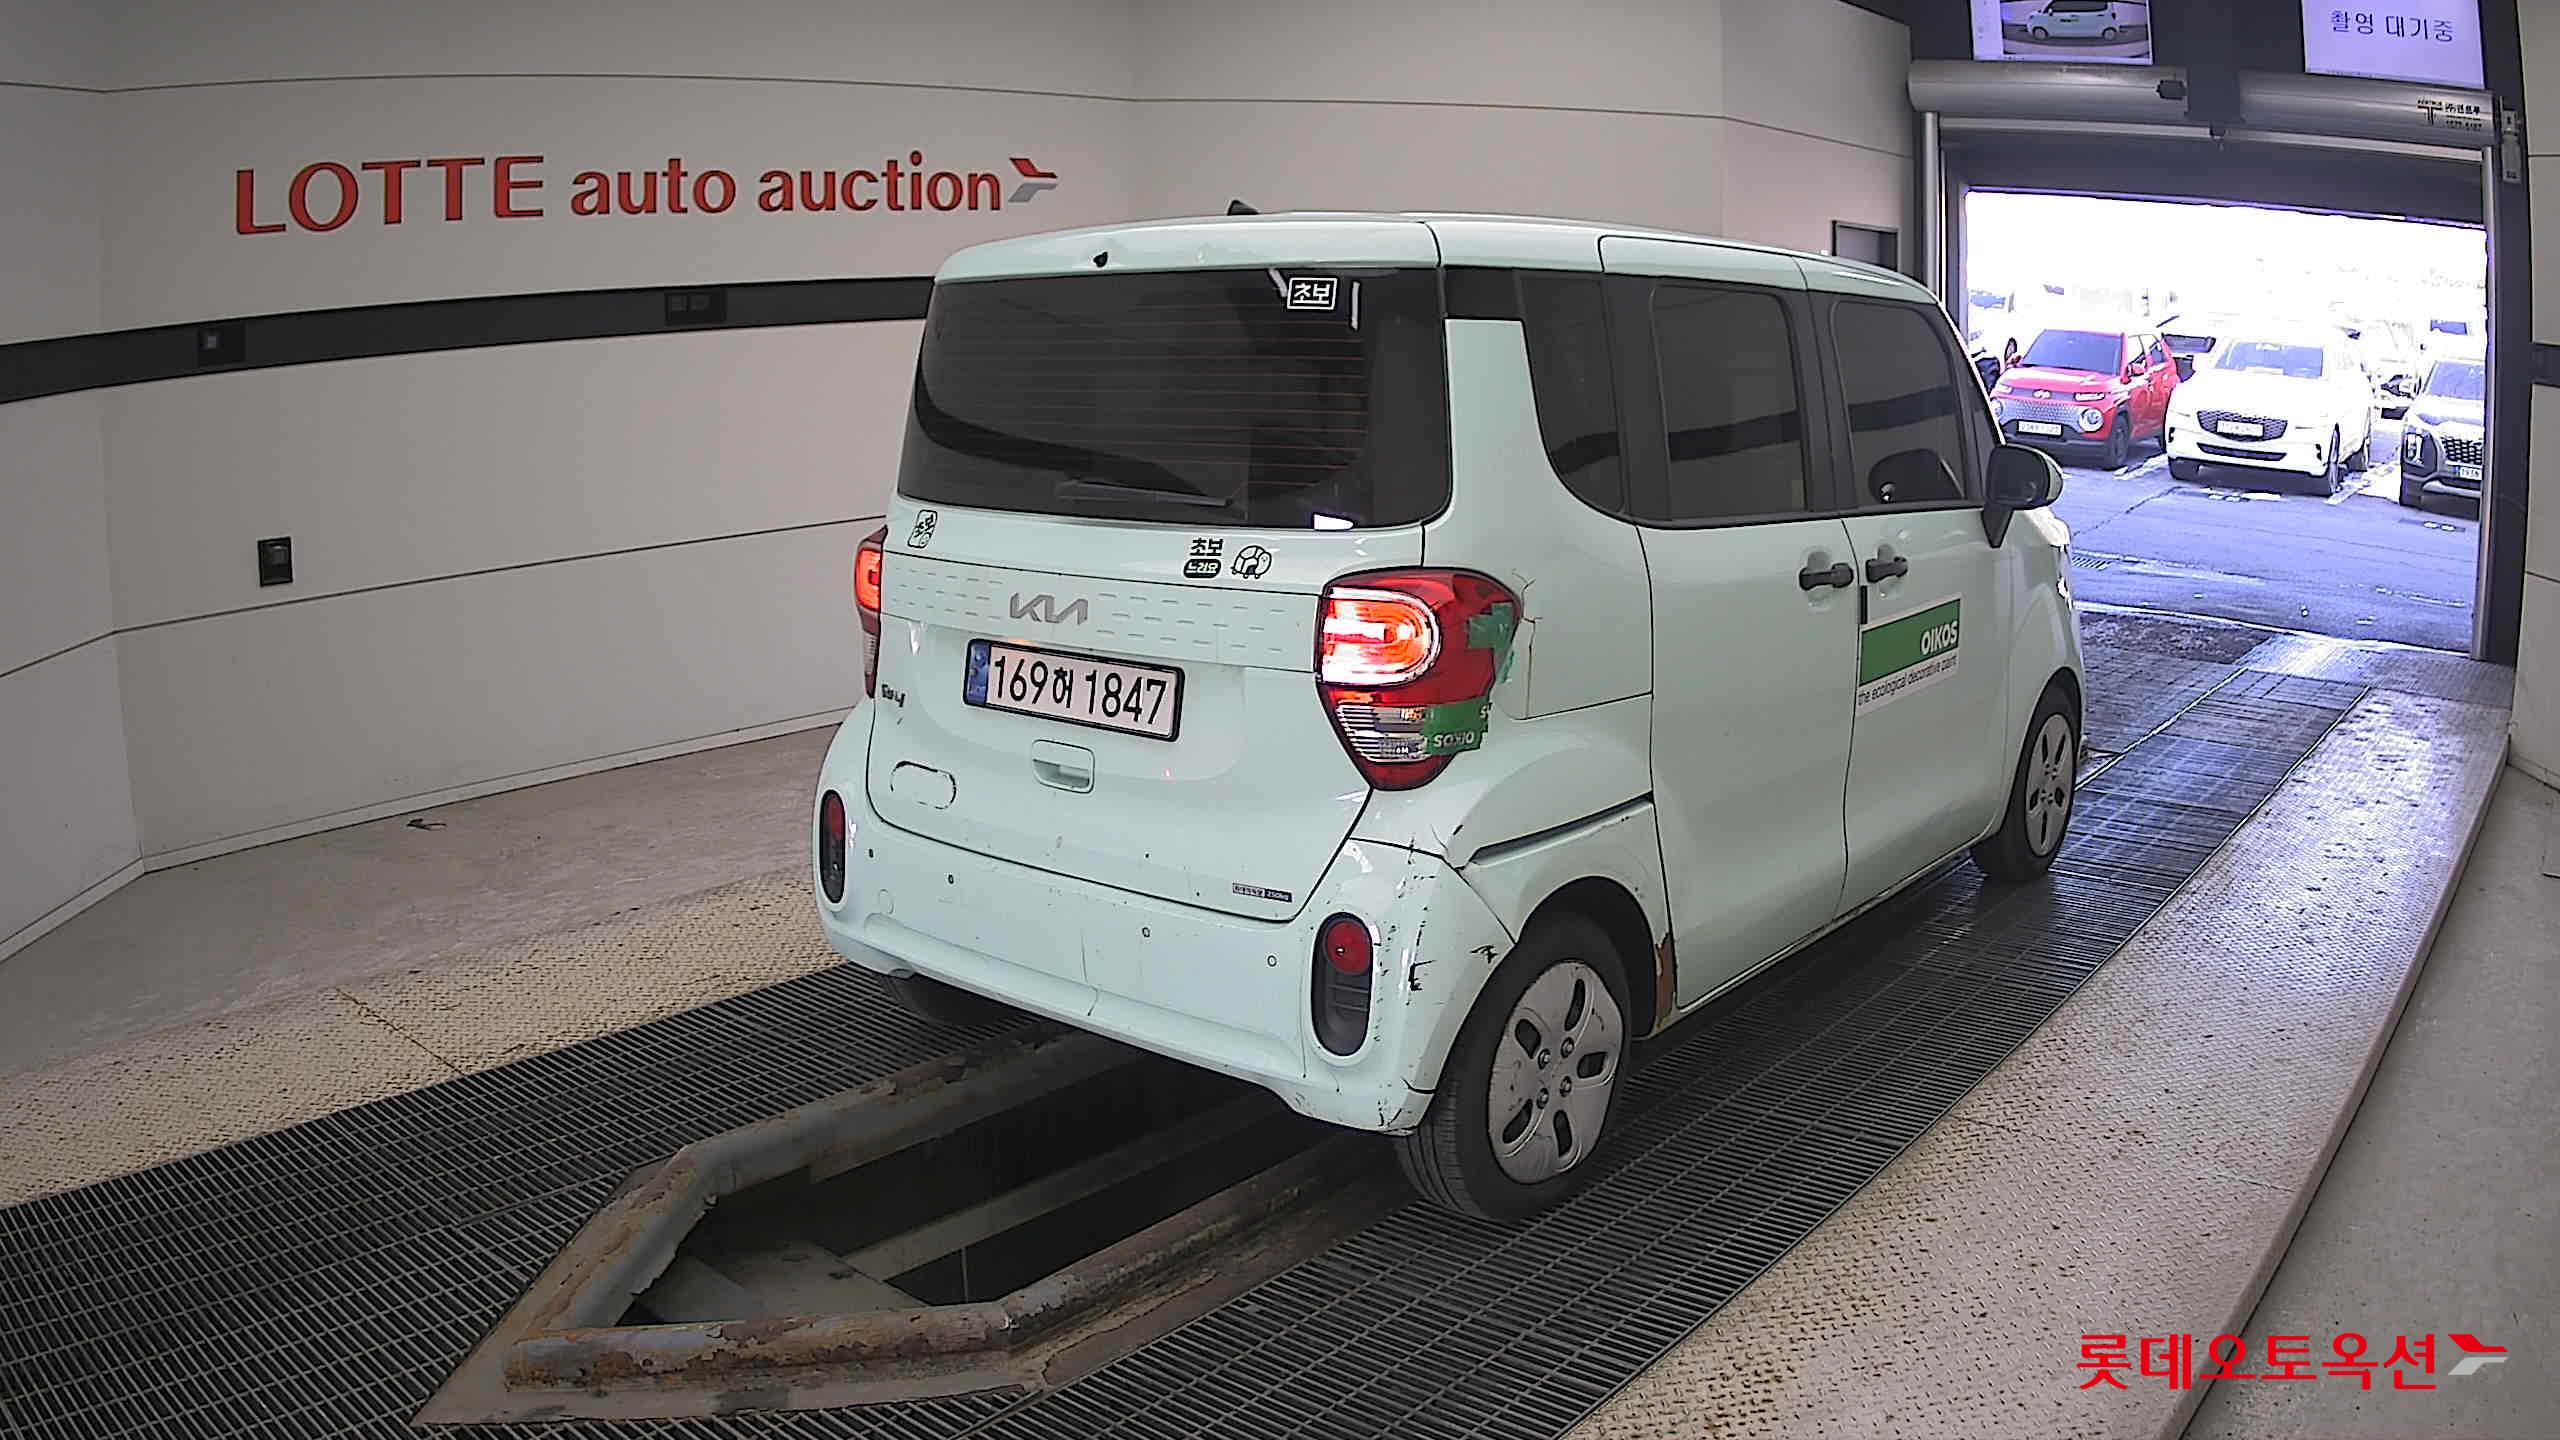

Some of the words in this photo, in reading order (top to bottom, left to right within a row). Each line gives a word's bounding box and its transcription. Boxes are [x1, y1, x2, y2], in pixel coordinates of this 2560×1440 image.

[2331, 10, 2375, 35] 촬영
[2385, 15, 2453, 43] 대기중
[235, 155, 545, 235] LOTTE
[570, 157, 737, 216] auto
[757, 150, 1001, 213] auction
[1292, 282, 1331, 305] 초보
[1189, 537, 1224, 557] 초보
[1921, 620, 1958, 655] OIKOS
[994, 655, 1074, 709] 169허
[1085, 668, 1168, 725] 1847
